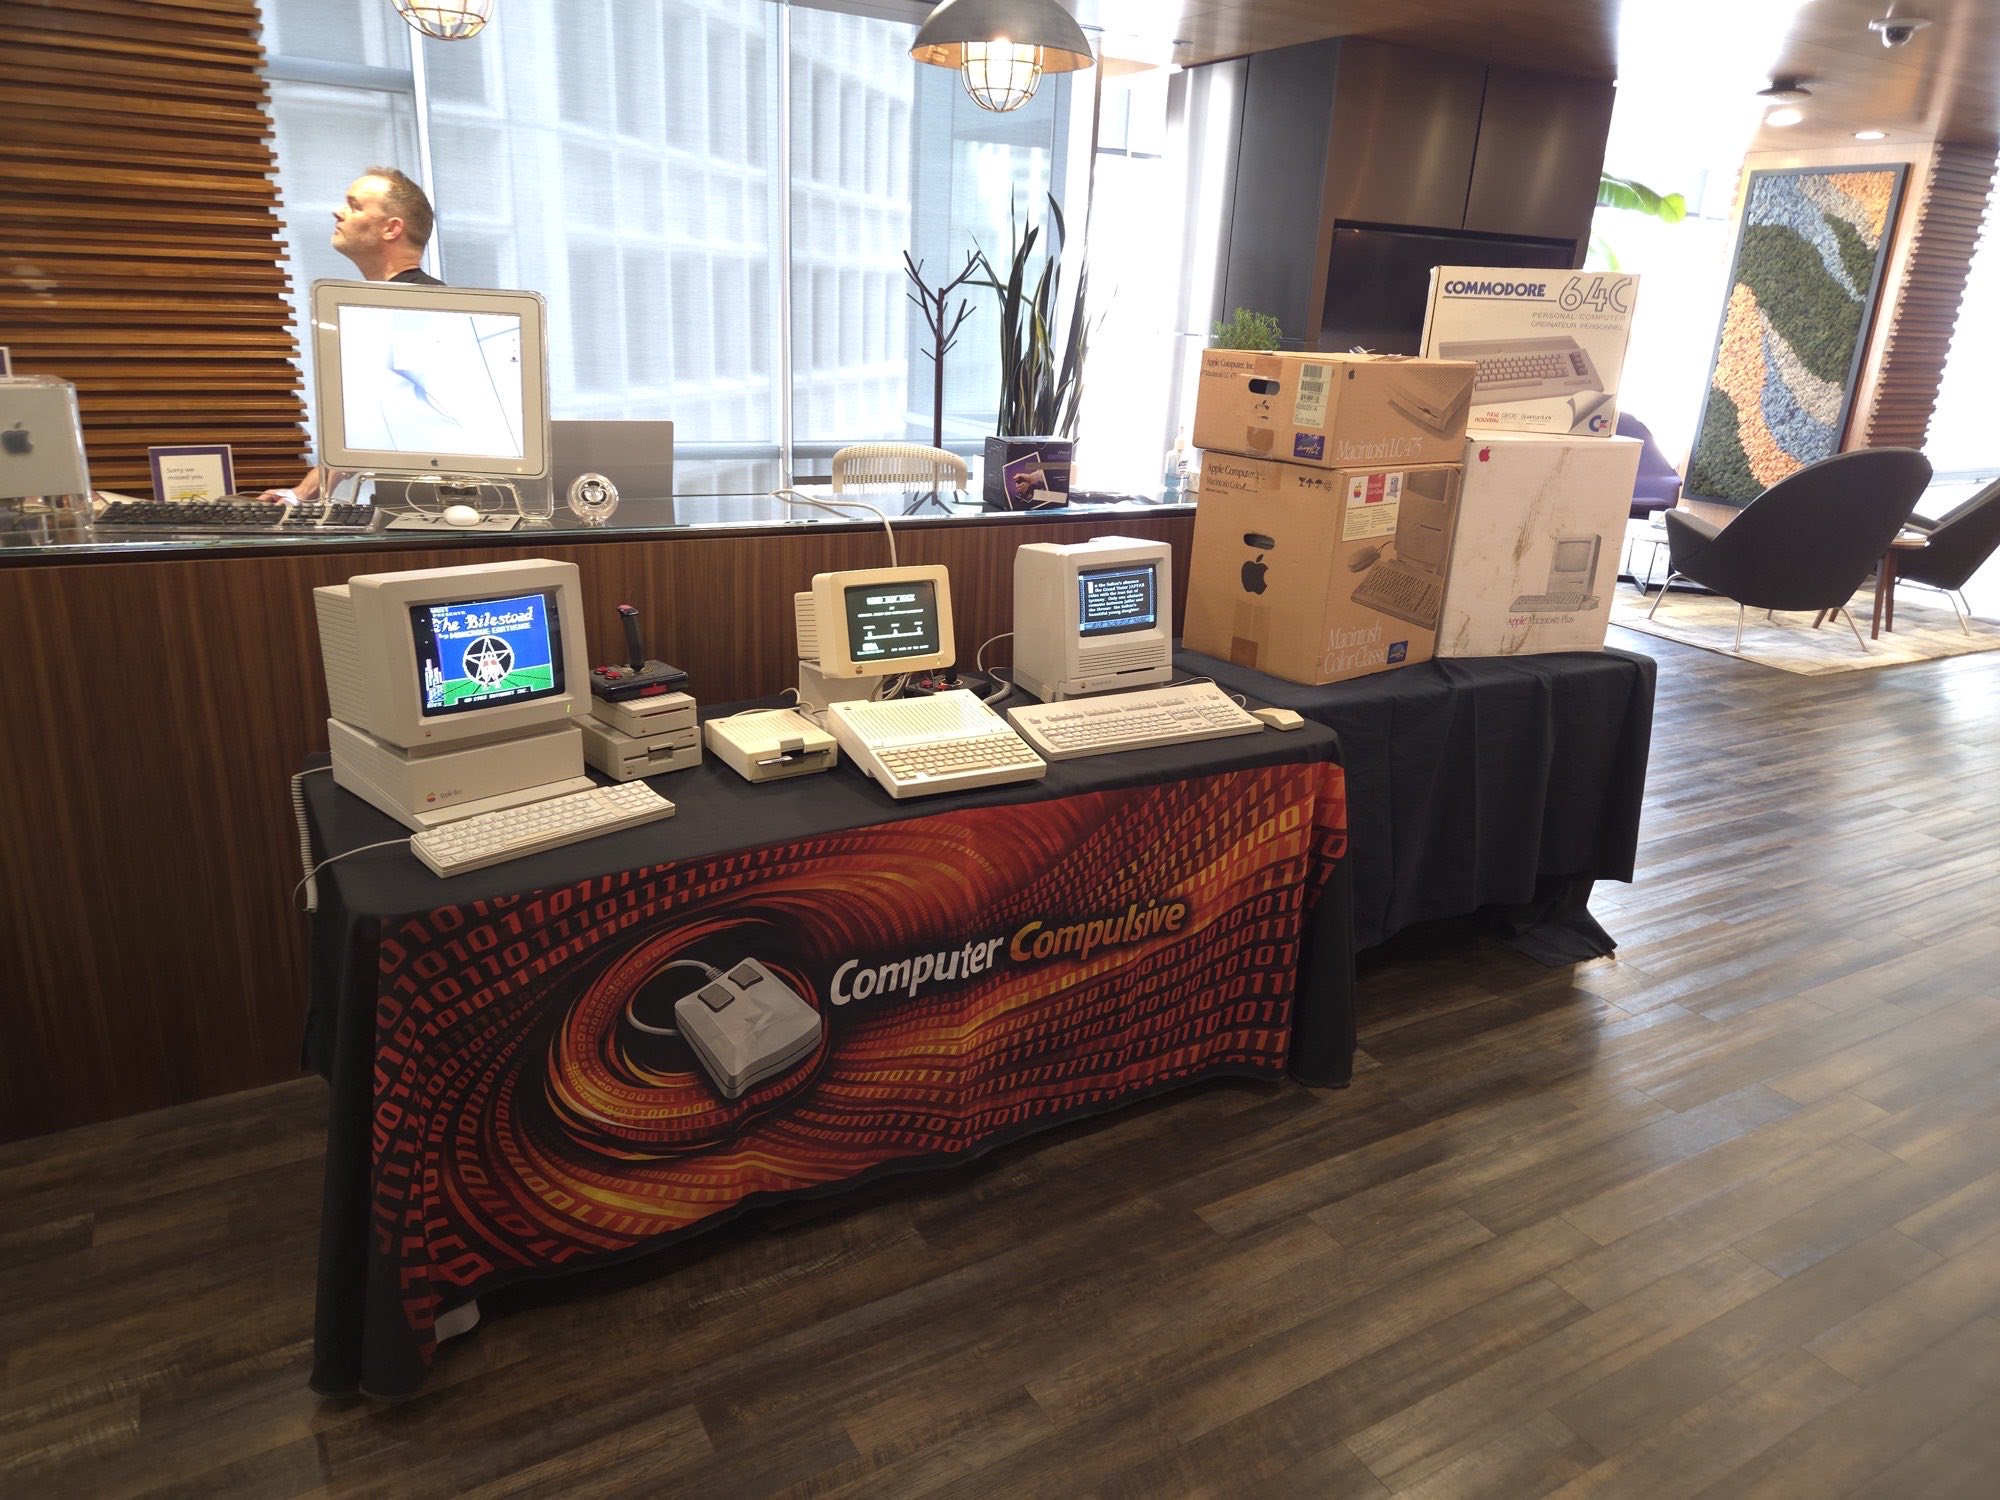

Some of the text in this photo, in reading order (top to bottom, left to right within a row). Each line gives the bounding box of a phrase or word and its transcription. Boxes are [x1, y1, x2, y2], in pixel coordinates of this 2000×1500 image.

[1444, 276, 1633, 314] COMMODORE 64C
[1530, 320, 1625, 331] ORDINATEUR PERSONNEL
[1532, 311, 1626, 321] PERSONAL COMPUTER
[1207, 358, 1220, 368] Apple
[1337, 438, 1389, 460] Macintosh
[1208, 464, 1224, 475] Apple
[432, 617, 461, 634] The
[465, 606, 534, 630] Bilestoad
[1328, 620, 1381, 651] Macintosh
[1325, 651, 1354, 675] Color
[830, 899, 1186, 1007] Computer Compulsive
